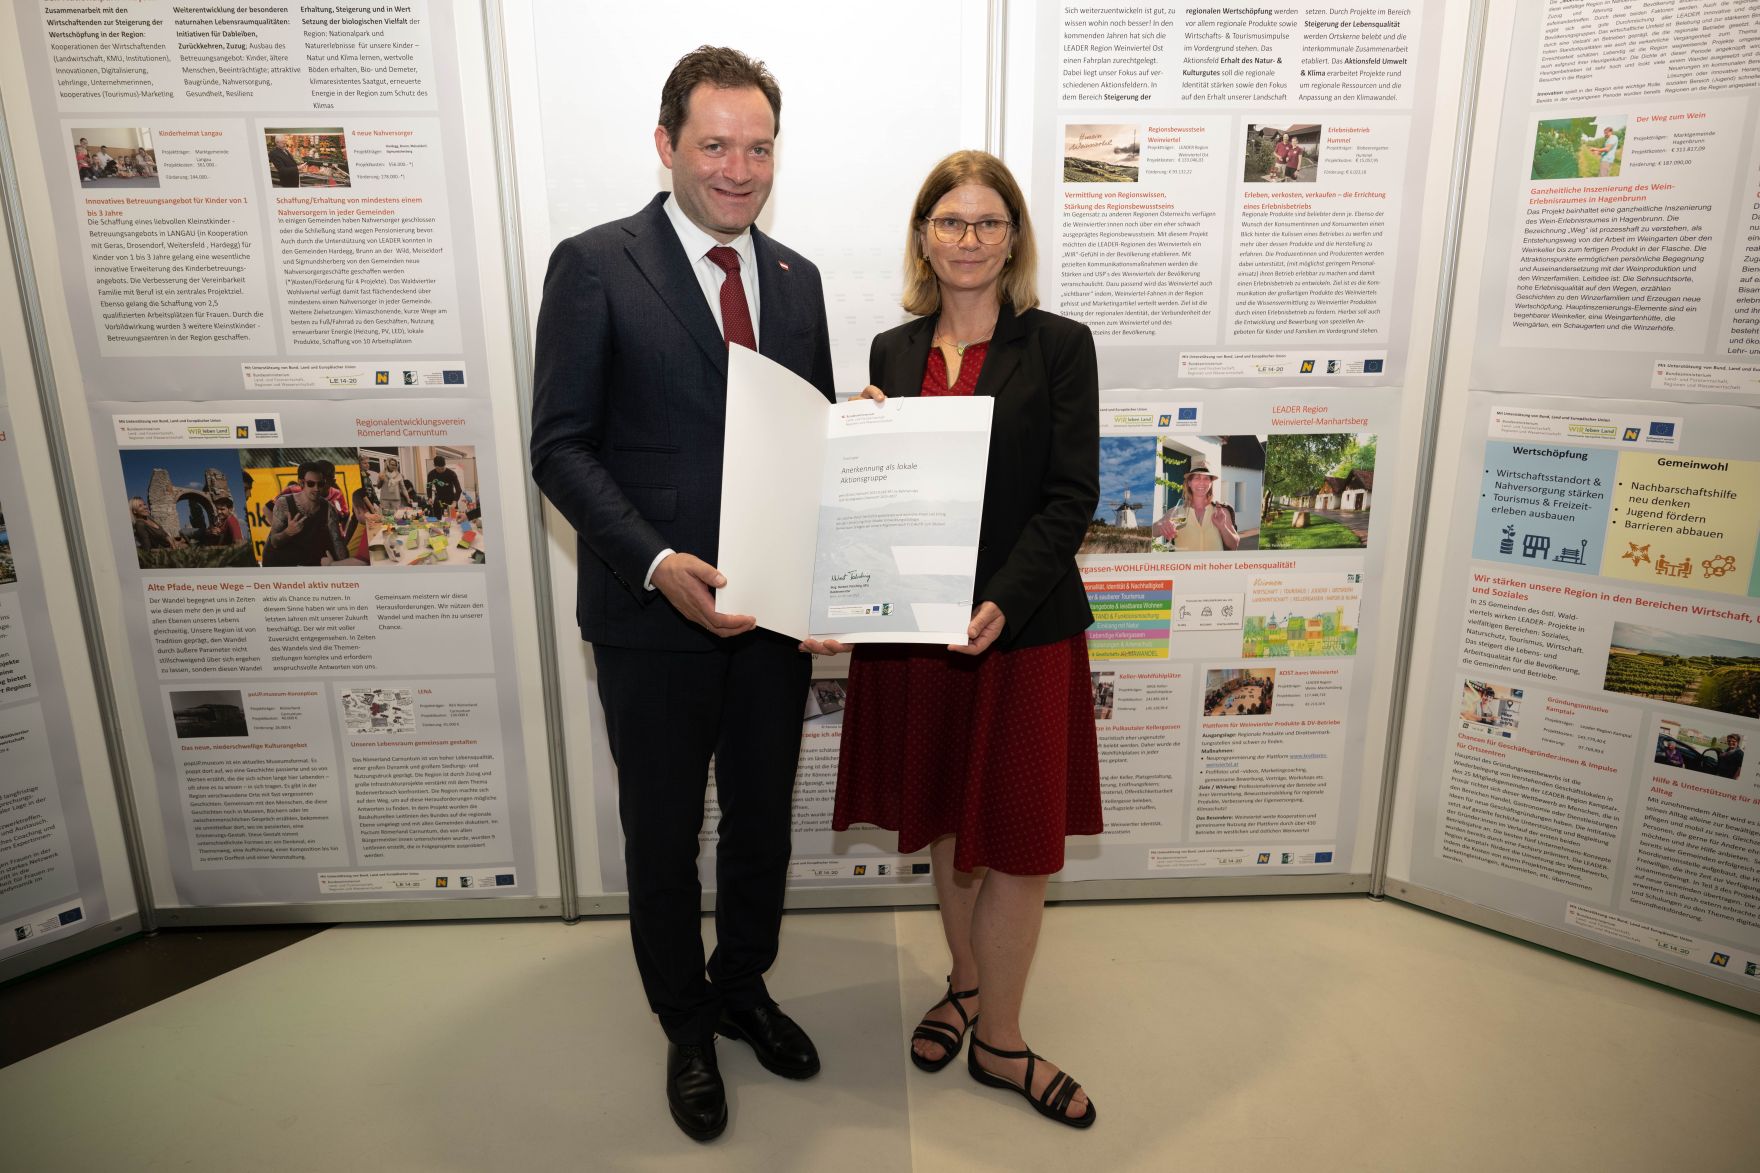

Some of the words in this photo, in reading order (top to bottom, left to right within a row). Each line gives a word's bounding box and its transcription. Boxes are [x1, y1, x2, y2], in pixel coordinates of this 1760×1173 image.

[337, 209, 354, 218] jeder
[1107, 204, 1174, 212] Regionsbewusstseins
[1302, 406, 1328, 414] Region
[356, 418, 465, 427] Regionalentwicklungsverein
[1513, 447, 1588, 461] Wertschöpfung
[1658, 458, 1728, 471] Gemeinwohl
[840, 475, 887, 483] Aktionsgruppe
[1497, 470, 1591, 485] Wirtschaftsstandort
[1593, 478, 1601, 486] &
[1495, 482, 1565, 497] Nahversorgung
[1568, 490, 1604, 499] stärken
[1632, 482, 1737, 499] Nachbarschaftshilfe
[1494, 494, 1540, 505] Tourismus
[1554, 500, 1591, 510] Freizeit-
[1652, 497, 1690, 508] denken
[1492, 506, 1526, 516] erleben
[1529, 511, 1575, 521] ausbauen
[1626, 508, 1663, 518] Jugend
[1667, 511, 1706, 523] fördern
[1625, 520, 1672, 533] Barrieren
[1676, 526, 1723, 538] abbauen
[1235, 562, 1296, 570] Lebensqualität!
[220, 583, 244, 591] Wege
[1474, 574, 1491, 582] Wir
[1493, 578, 1527, 588] stärken
[1529, 584, 1562, 593] unsere
[1564, 587, 1597, 598] Region
[1601, 592, 1610, 601] in
[1613, 595, 1632, 604] den
[1635, 598, 1688, 612] Bereichen
[1692, 606, 1752, 623] Wirtschaft,
[1492, 589, 1528, 600] Soziales
[1468, 745, 1506, 758] Ortszentren
[1589, 762, 1617, 773] Impulse
[1651, 787, 1673, 797] Alltag
[1681, 783, 1737, 800] Unterstützung
[1739, 795, 1751, 804] für
